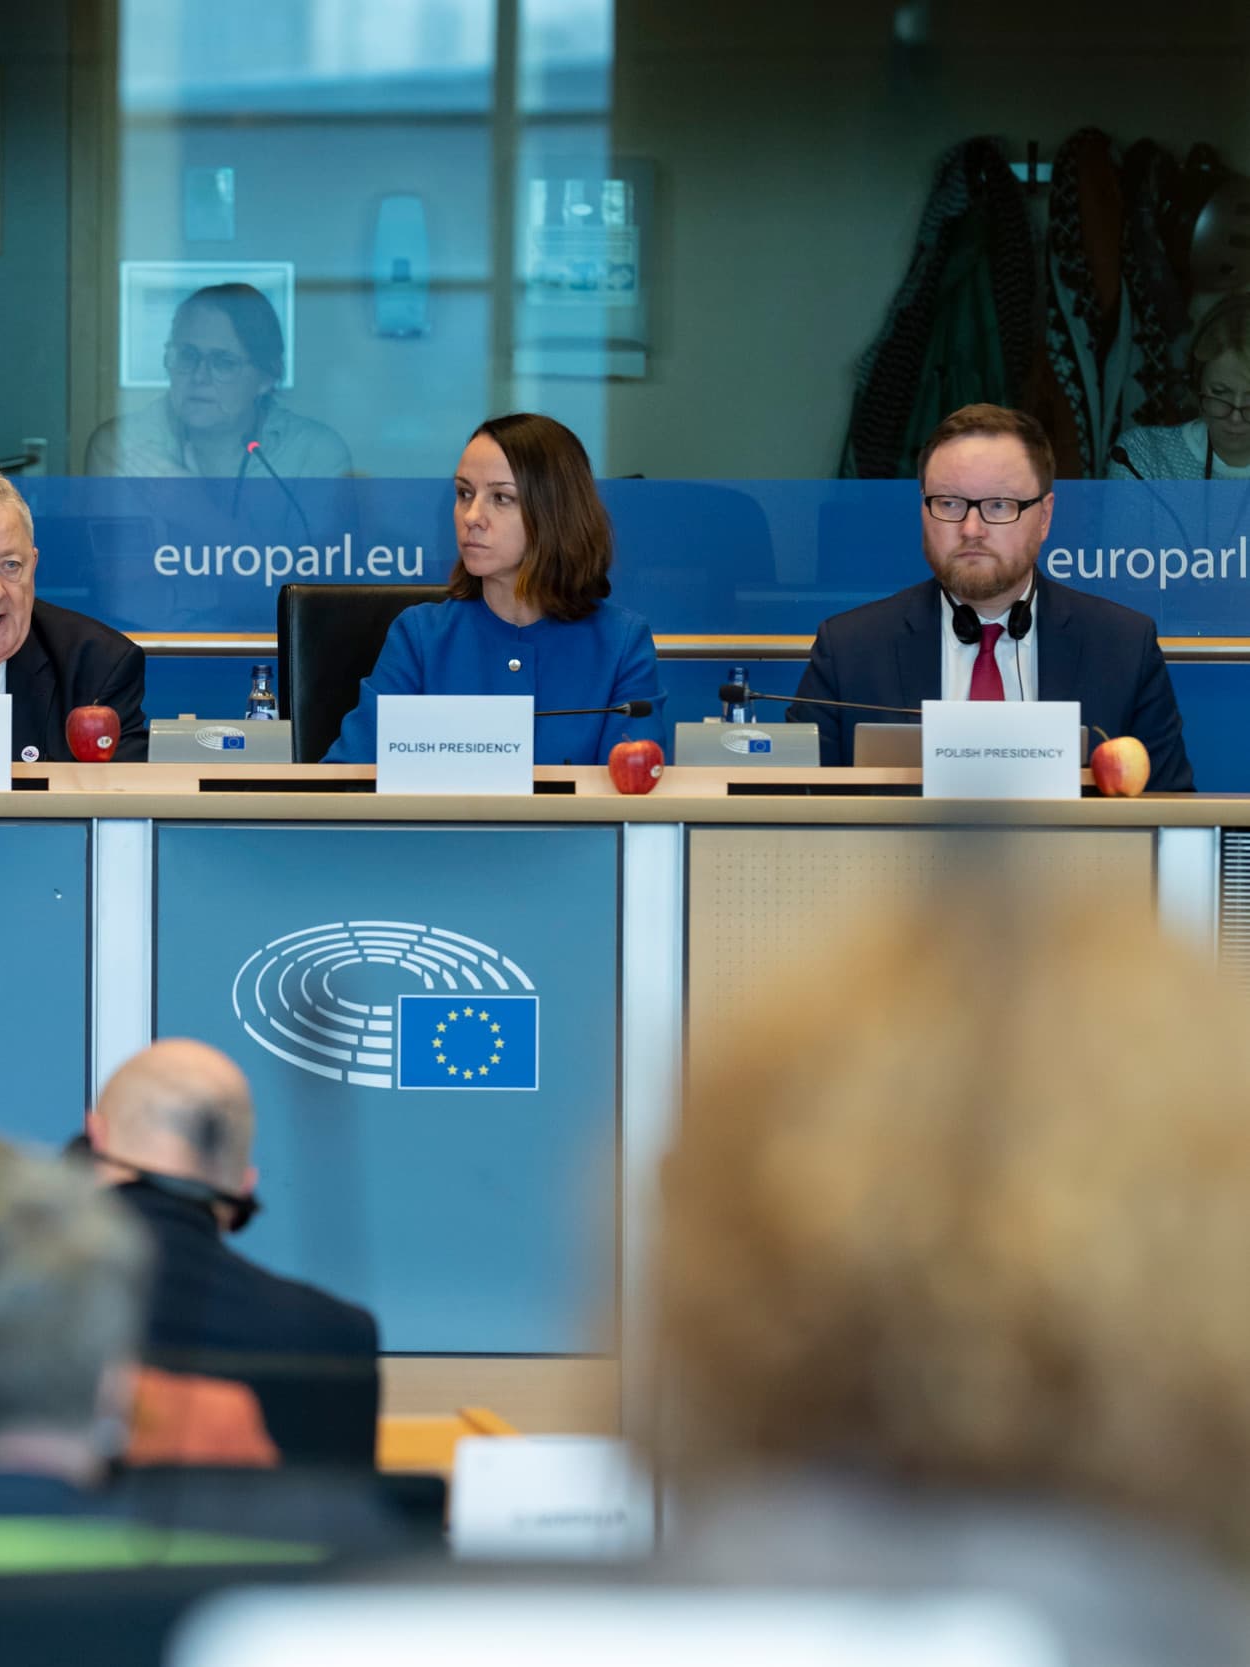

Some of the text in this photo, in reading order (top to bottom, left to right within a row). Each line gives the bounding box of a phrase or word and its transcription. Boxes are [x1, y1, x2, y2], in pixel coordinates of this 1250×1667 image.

[153, 533, 424, 587] europarl.eu
[1047, 535, 1247, 590] europarl
[388, 742, 522, 754] POLISH PRESIDENCY
[935, 748, 1065, 759] POLISH PRESIDENCY
